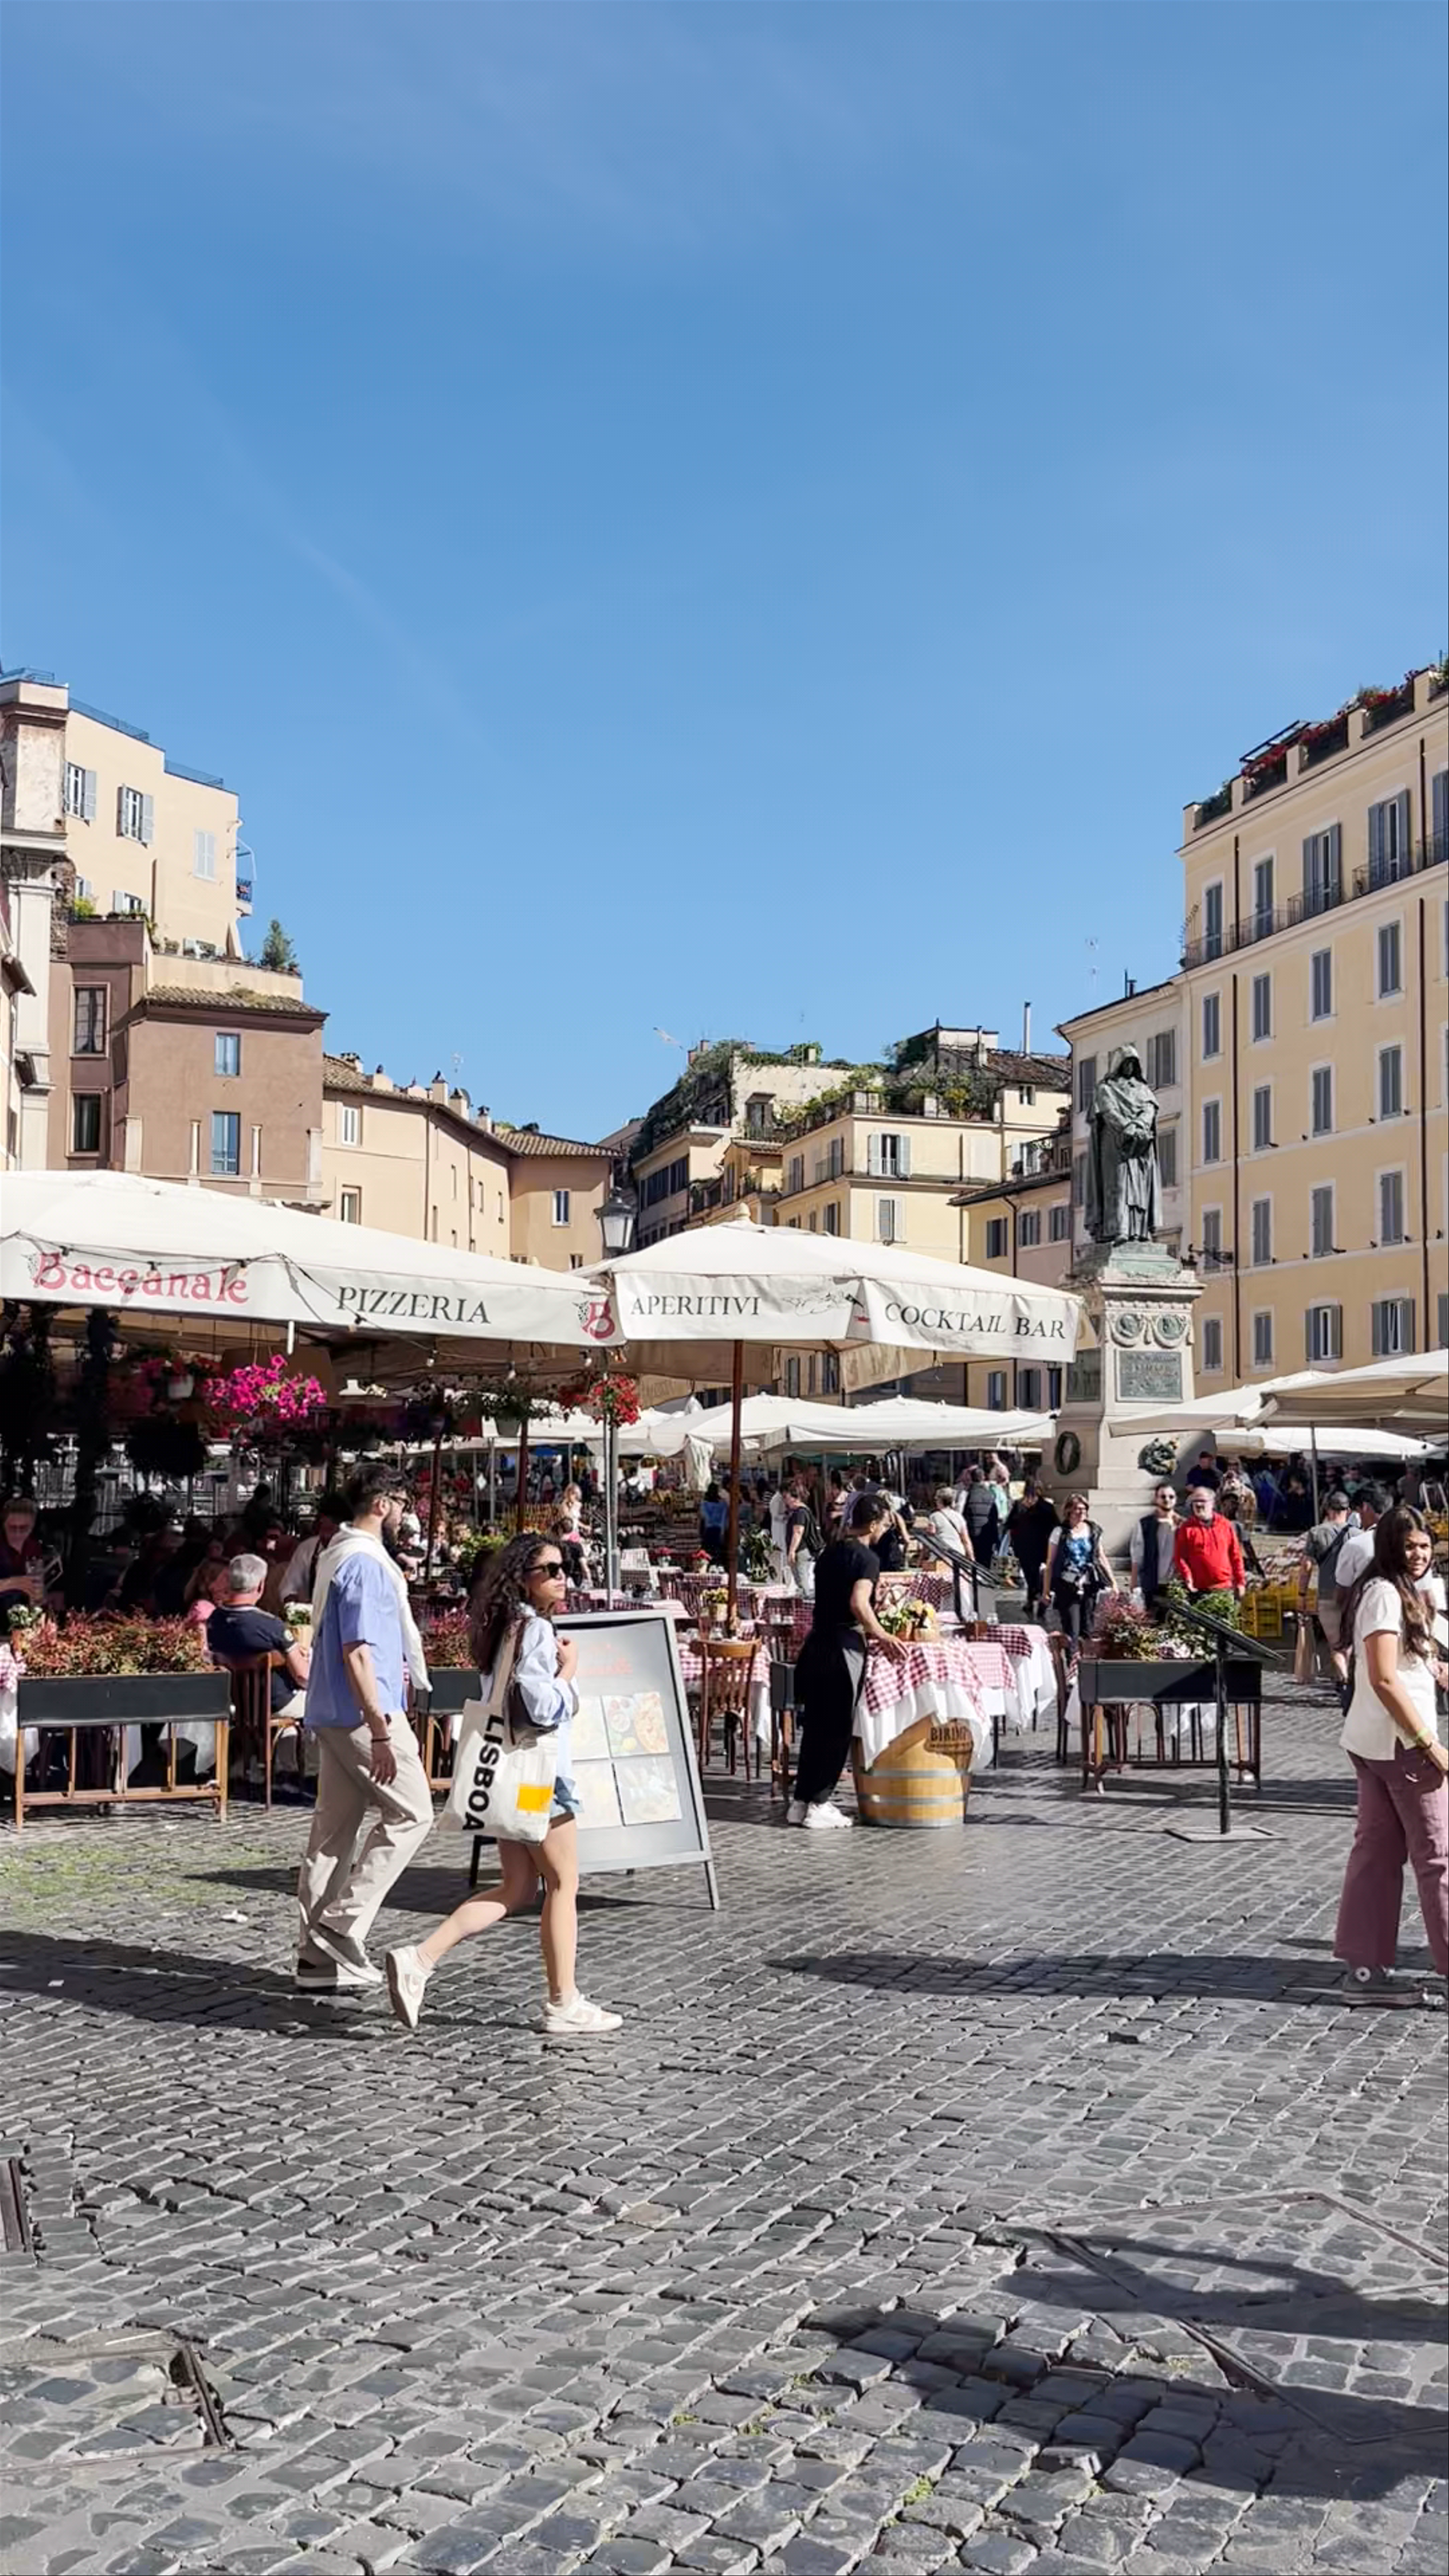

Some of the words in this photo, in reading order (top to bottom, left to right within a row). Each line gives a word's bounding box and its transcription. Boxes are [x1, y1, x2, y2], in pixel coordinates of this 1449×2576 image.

[34, 1252, 249, 1304] Baccanale
[337, 1286, 491, 1324] PIZZERIA
[631, 1295, 760, 1315] APERITIVI
[885, 1303, 1006, 1333] COCKTAIL
[1014, 1316, 1066, 1339] BAR
[462, 1714, 505, 1831] LISBOA
